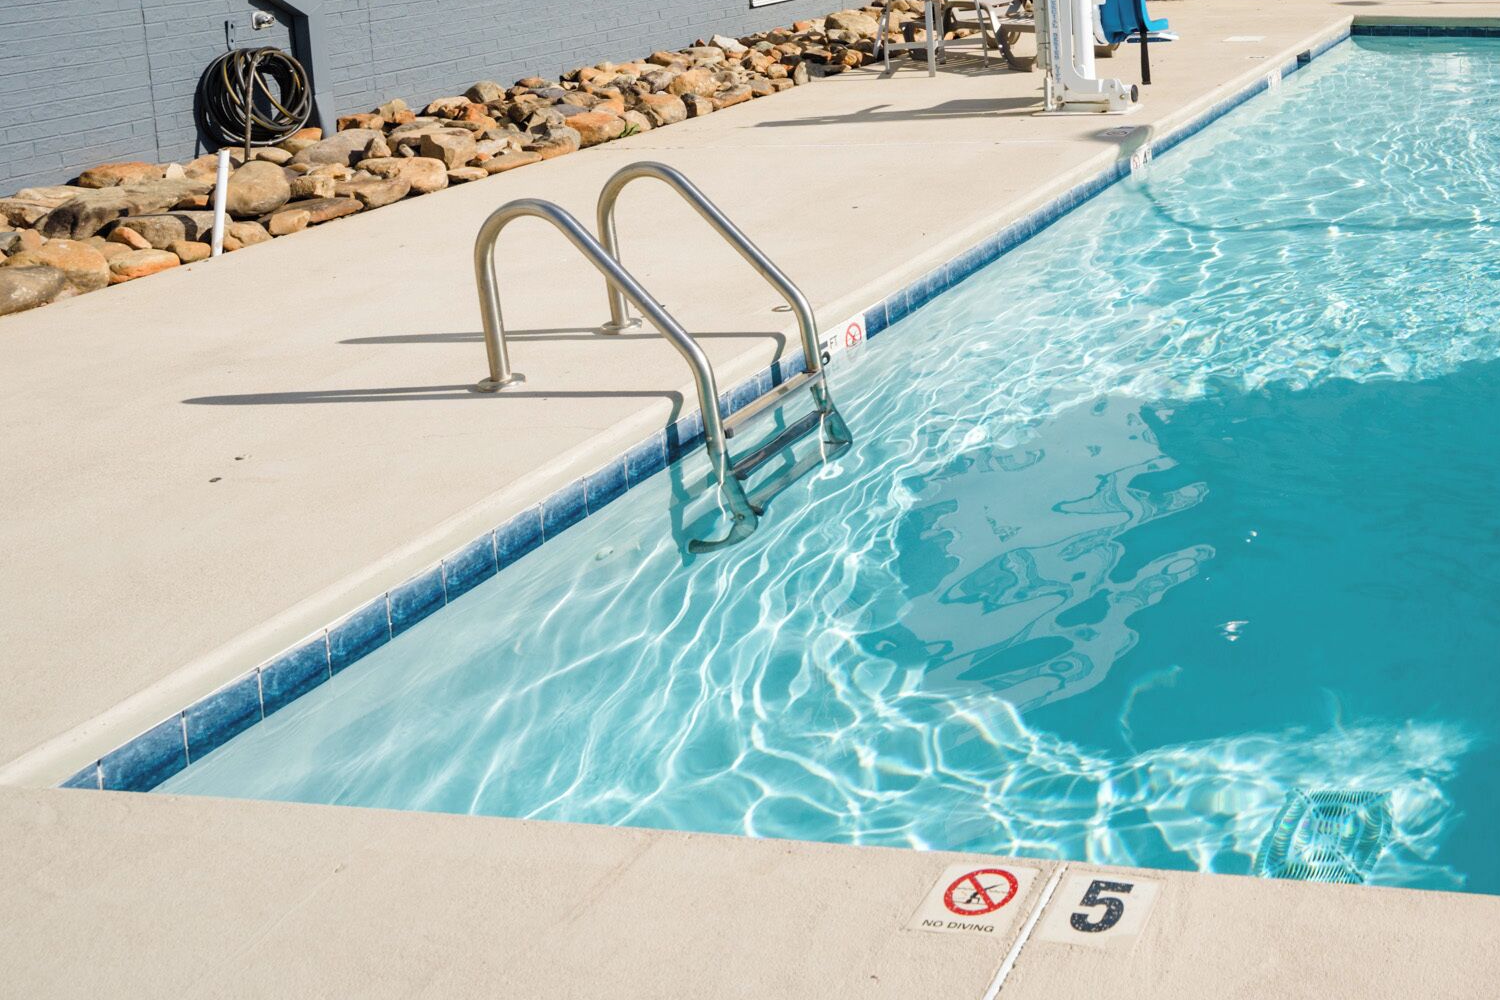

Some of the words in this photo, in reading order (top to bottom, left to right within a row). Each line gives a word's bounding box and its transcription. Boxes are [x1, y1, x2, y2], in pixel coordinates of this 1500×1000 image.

[1069, 879, 1134, 934] 5
[921, 919, 943, 927] NO
[946, 921, 995, 933] DIVING
